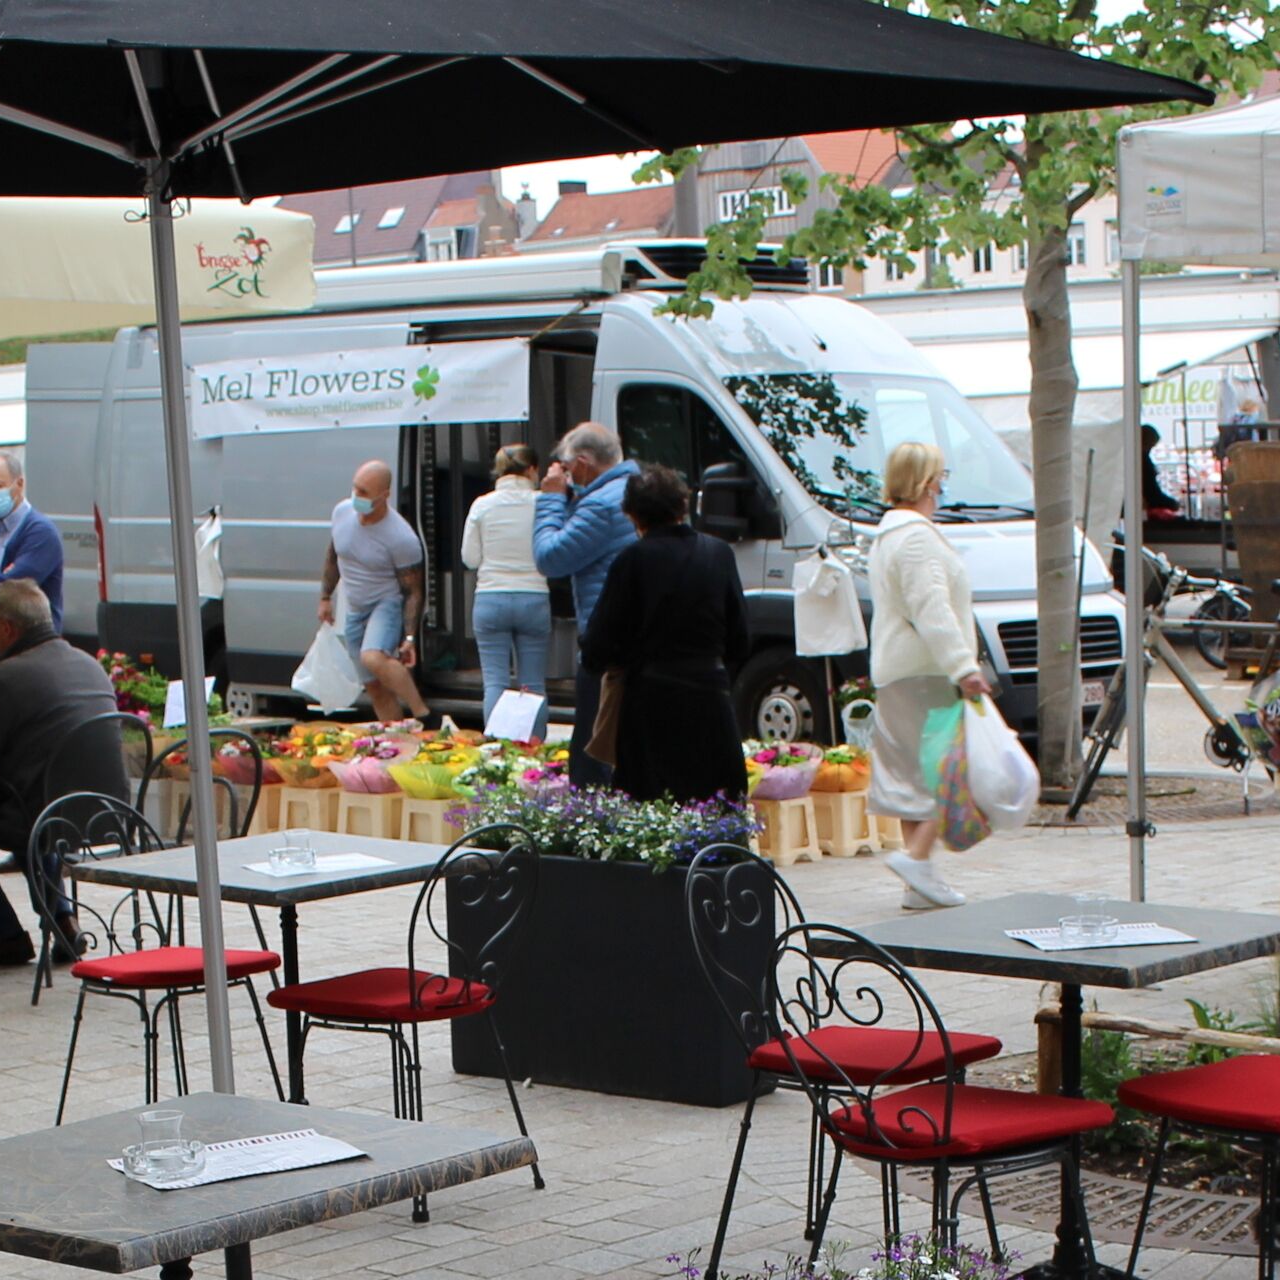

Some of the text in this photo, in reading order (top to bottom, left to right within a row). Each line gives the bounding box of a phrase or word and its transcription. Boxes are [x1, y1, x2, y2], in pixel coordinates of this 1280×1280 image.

[207, 268, 271, 299] Zot
[201, 367, 406, 405] Mel Flowers
